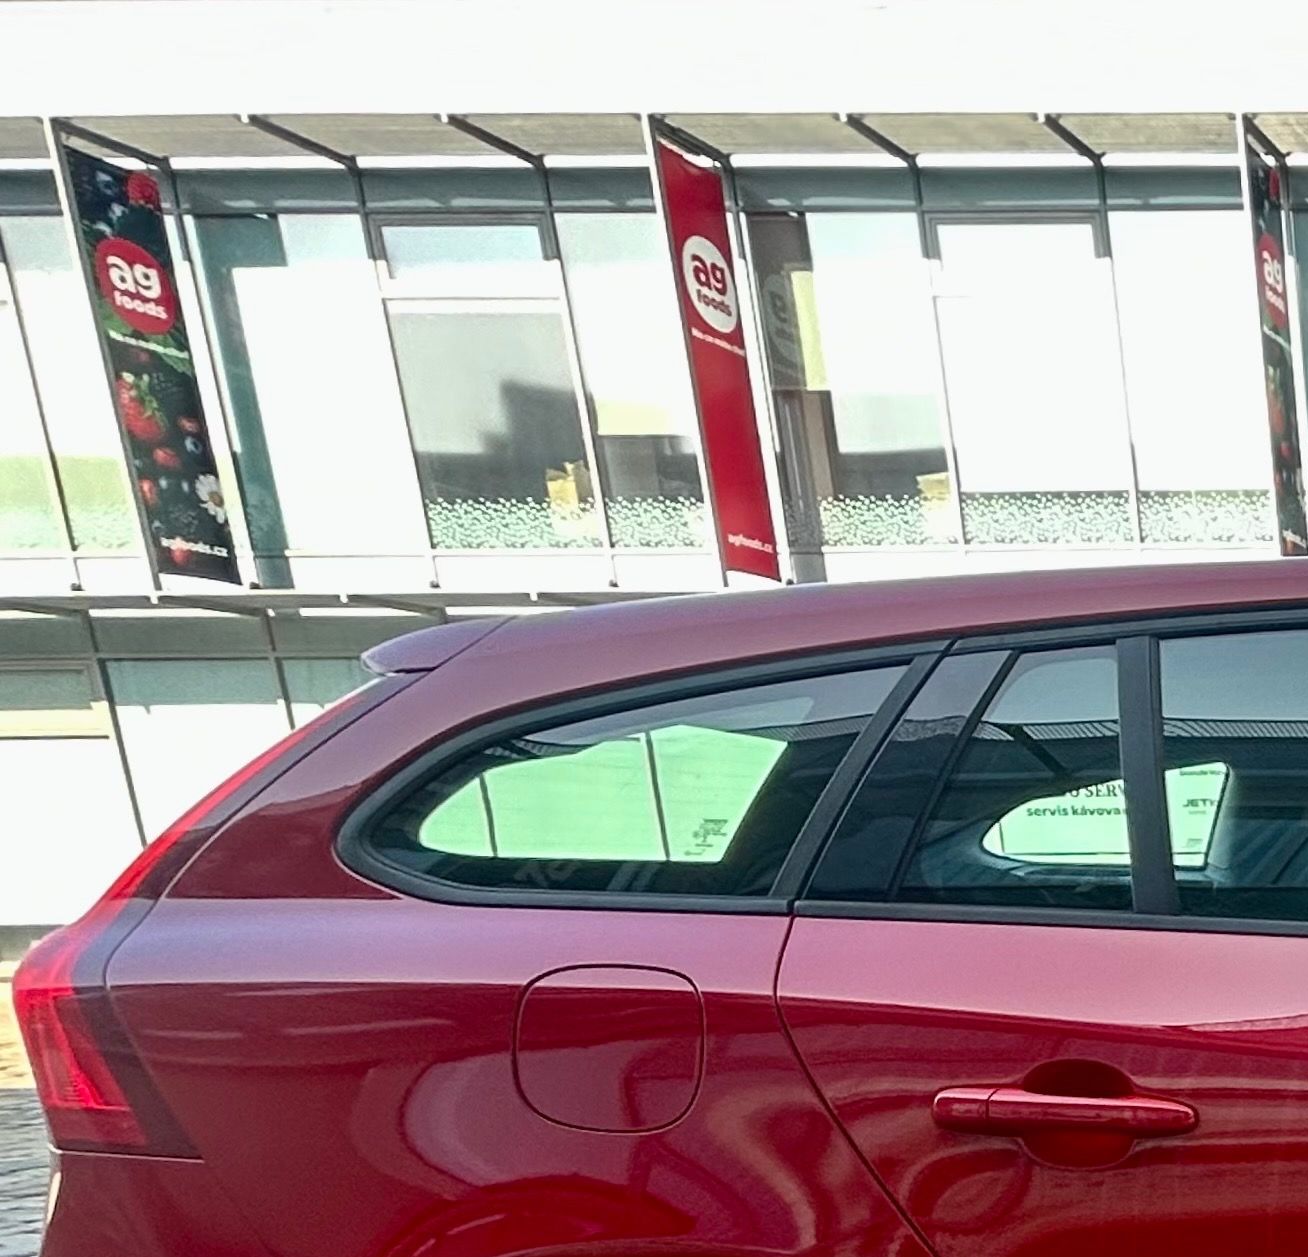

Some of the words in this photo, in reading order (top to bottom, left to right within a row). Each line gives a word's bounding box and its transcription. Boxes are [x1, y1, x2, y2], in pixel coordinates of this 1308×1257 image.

[106, 255, 161, 299] ag
[691, 254, 727, 296] ag
[113, 290, 168, 319] foods
[1027, 805, 1069, 816] servis
